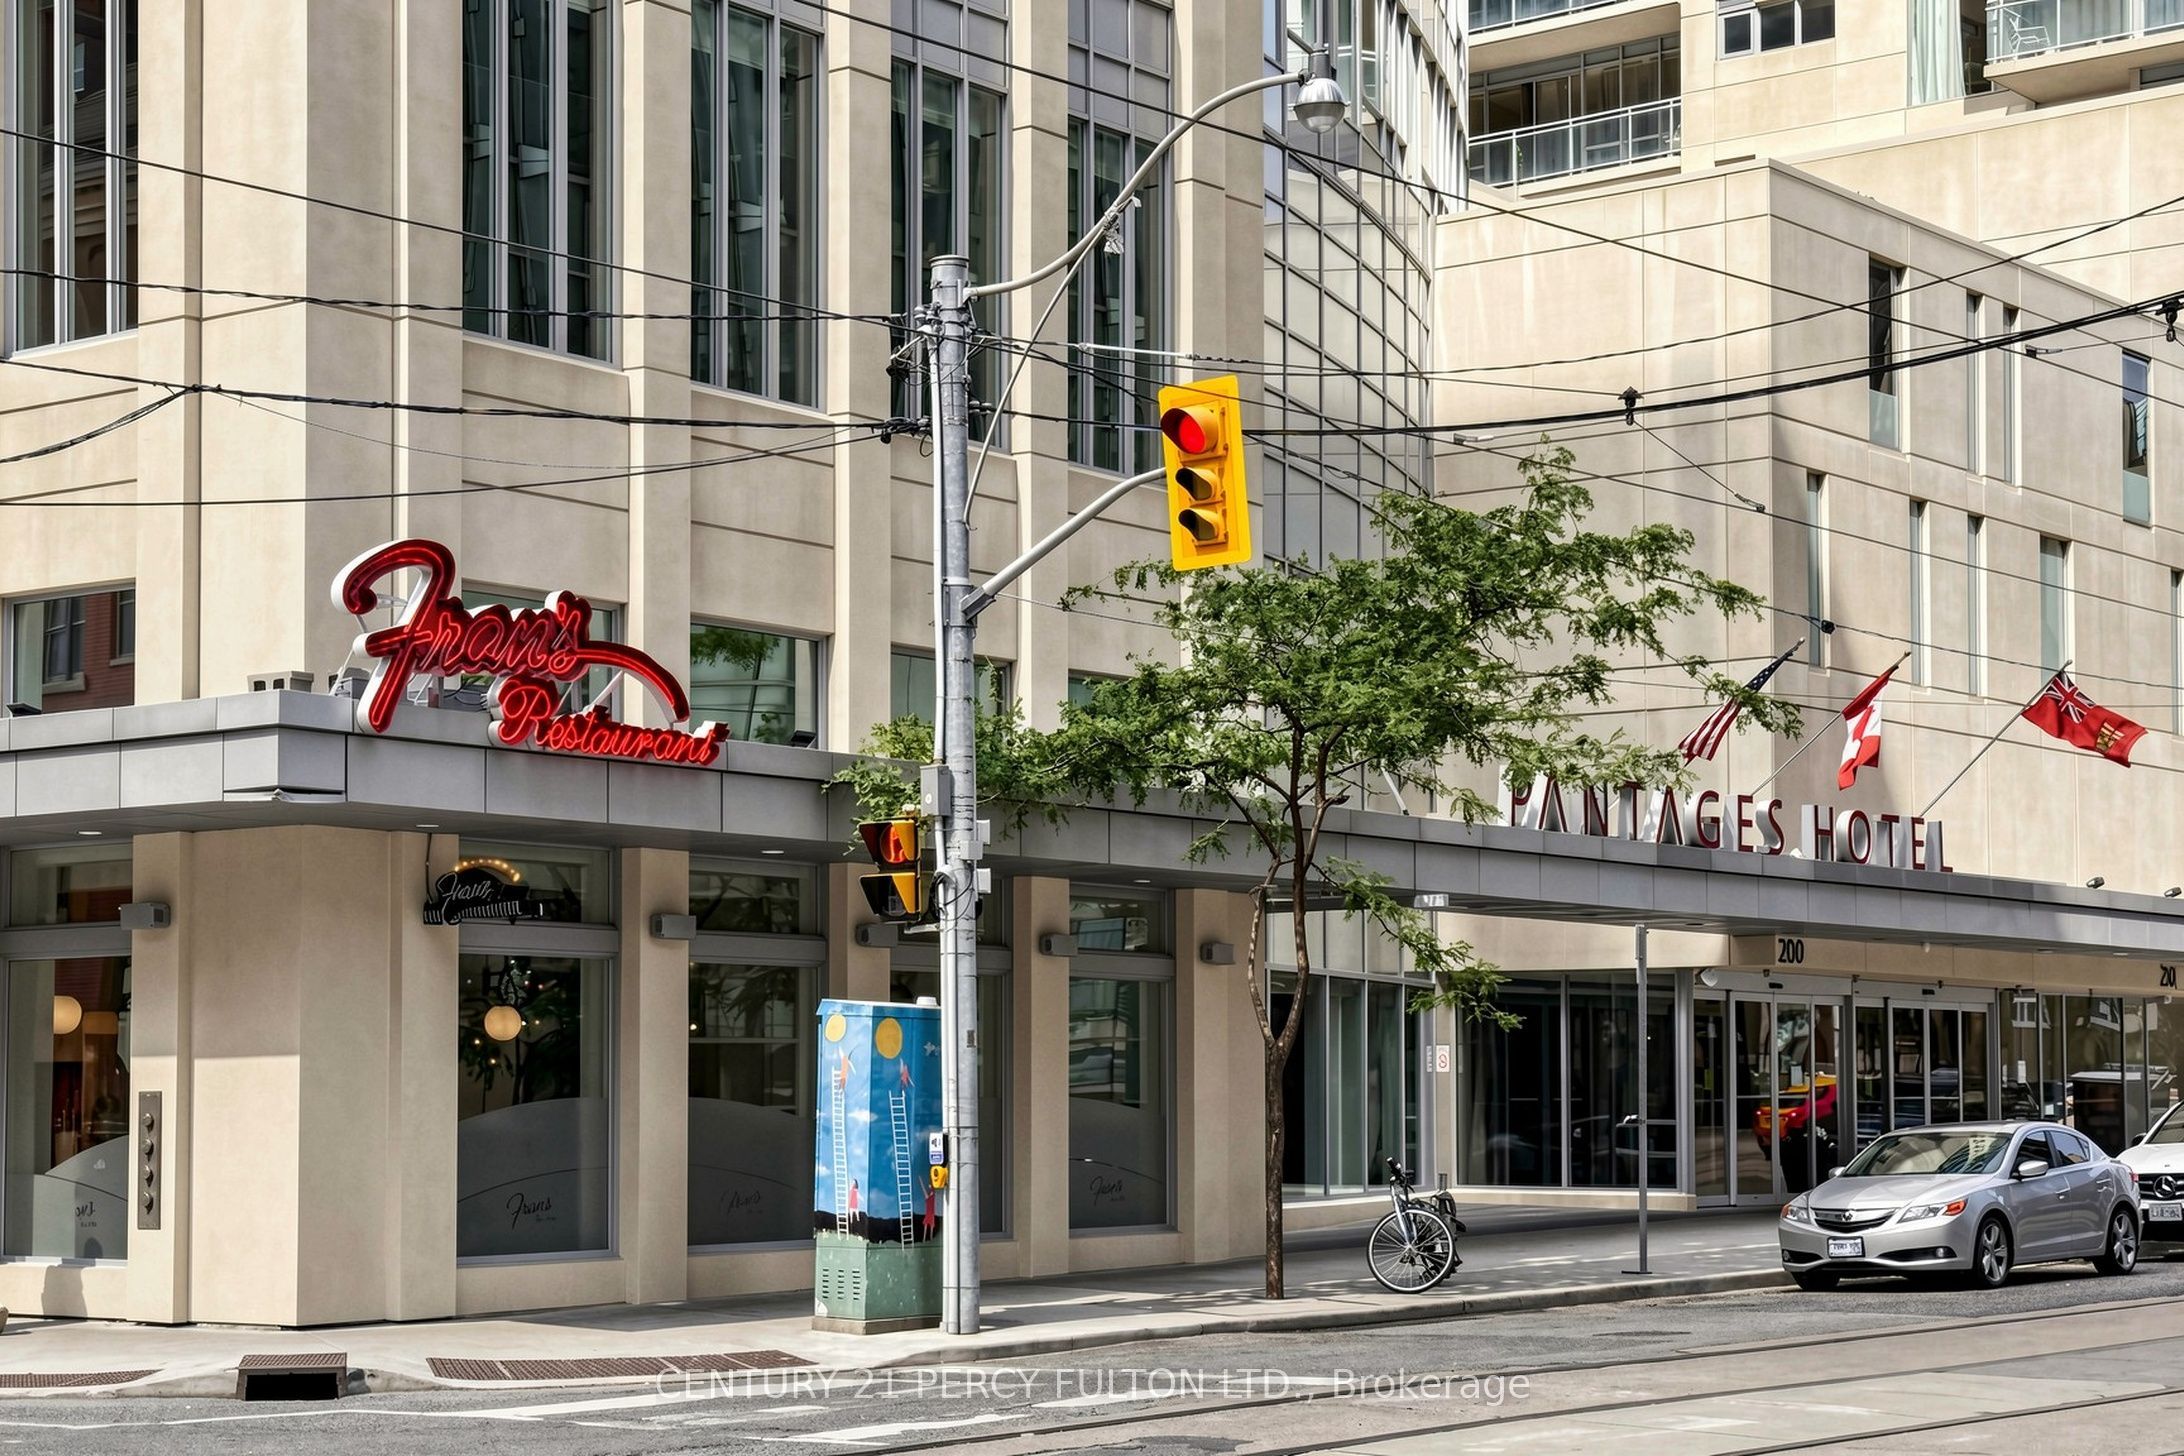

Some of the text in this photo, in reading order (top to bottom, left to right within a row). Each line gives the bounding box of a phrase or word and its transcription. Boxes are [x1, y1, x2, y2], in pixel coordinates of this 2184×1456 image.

[331, 538, 690, 734] Fran's
[488, 674, 731, 766] Restaurant
[1502, 764, 1954, 874] PANTAGES HOTEL
[1778, 938, 1804, 963] 200
